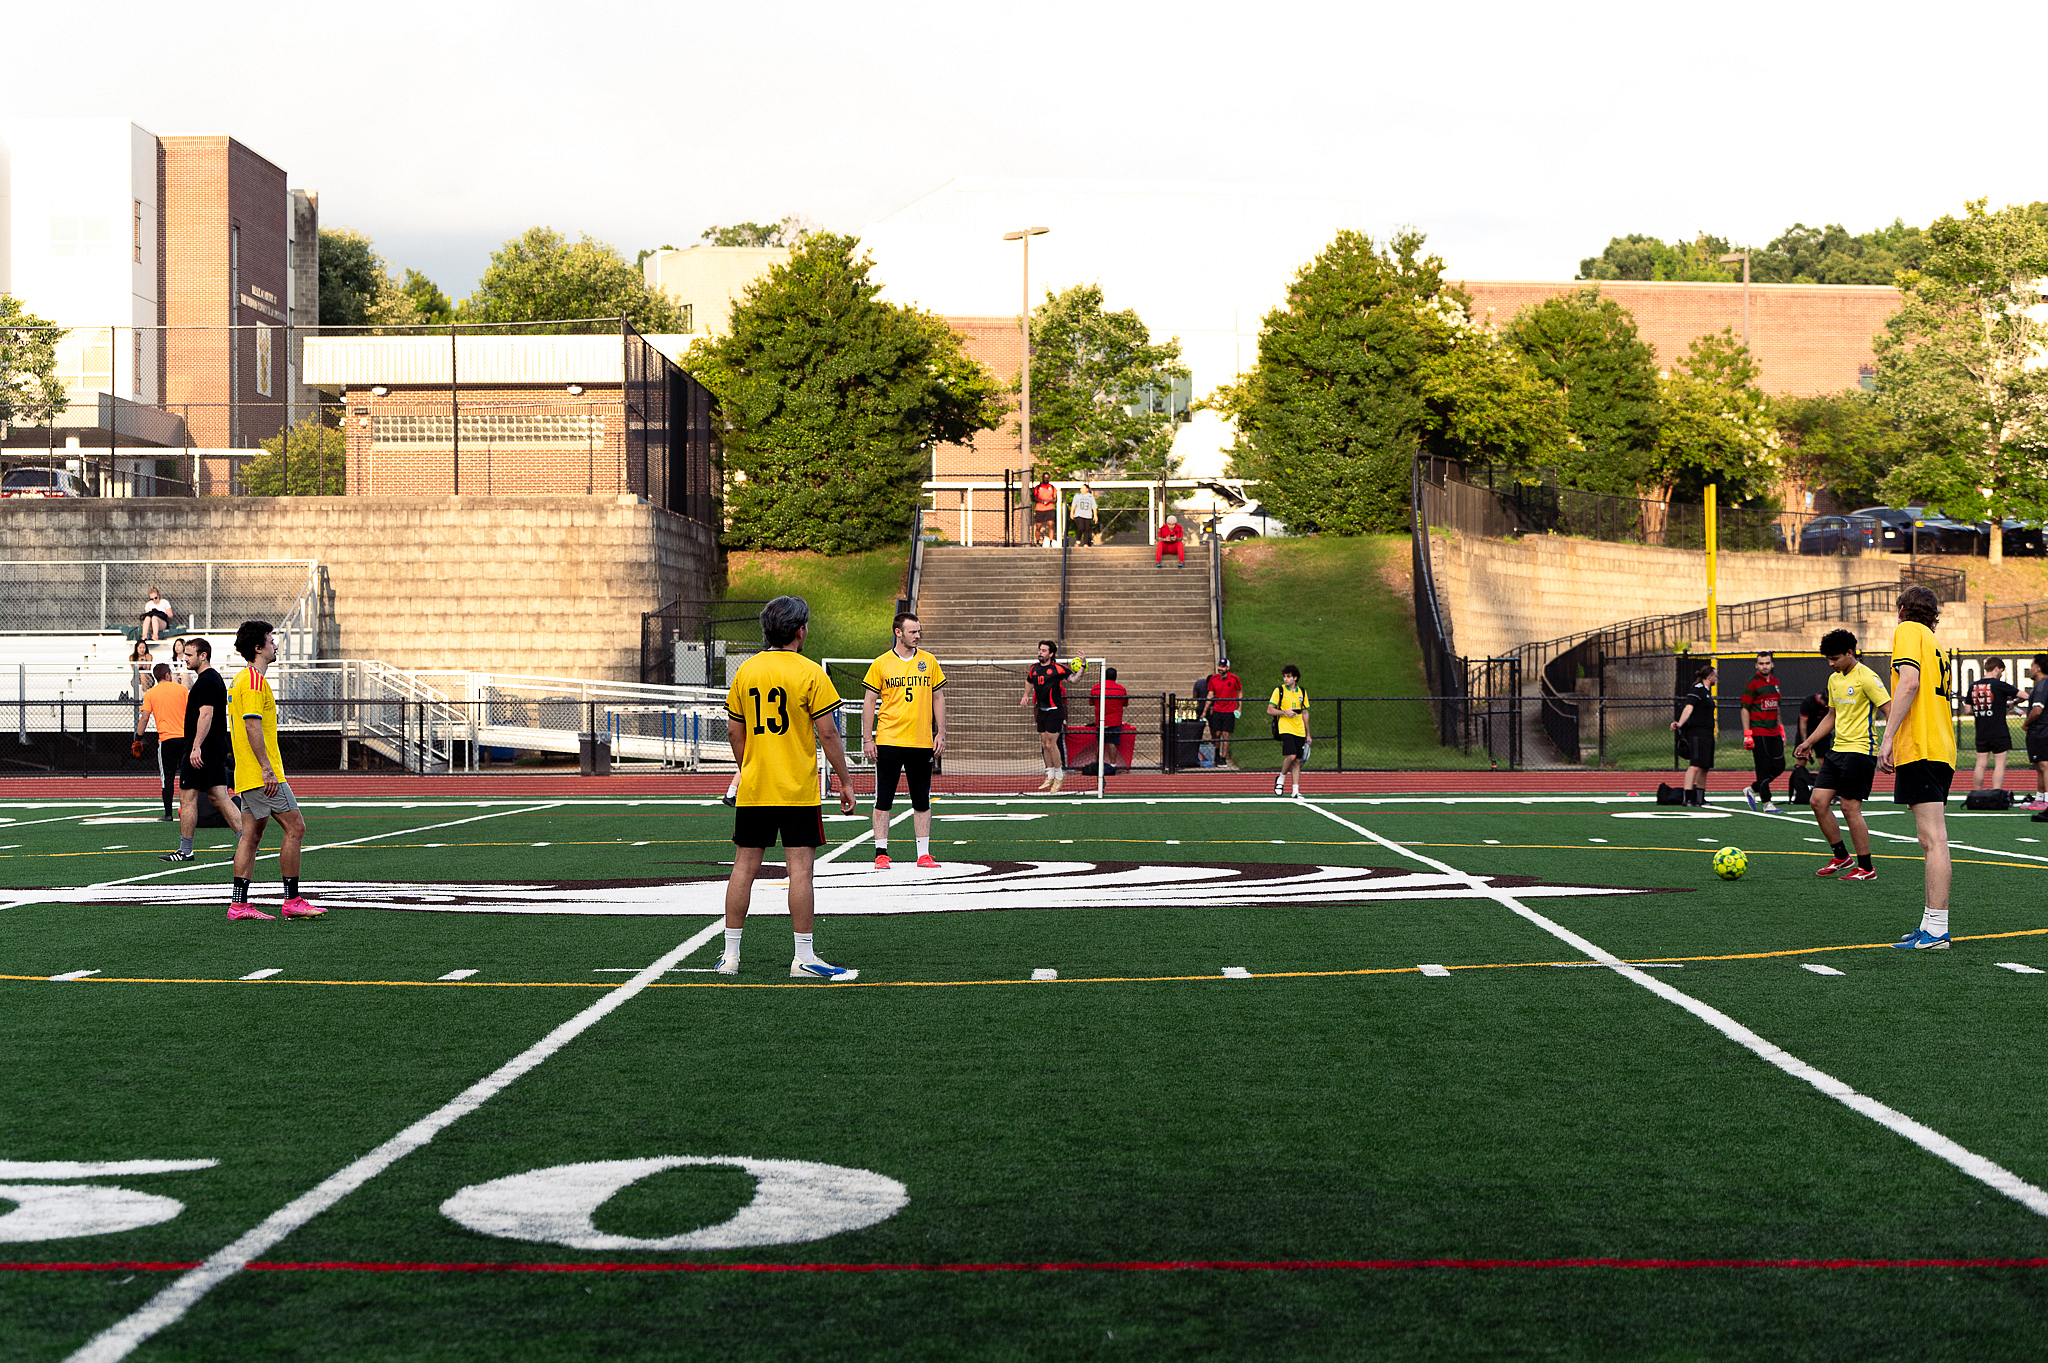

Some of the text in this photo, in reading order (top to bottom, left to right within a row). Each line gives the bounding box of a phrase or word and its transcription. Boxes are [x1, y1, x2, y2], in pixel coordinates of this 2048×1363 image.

[885, 676, 931, 688] MAGIC CITY FC
[1037, 675, 1045, 685] 10
[905, 688, 913, 702] 5
[749, 686, 790, 735] 13
